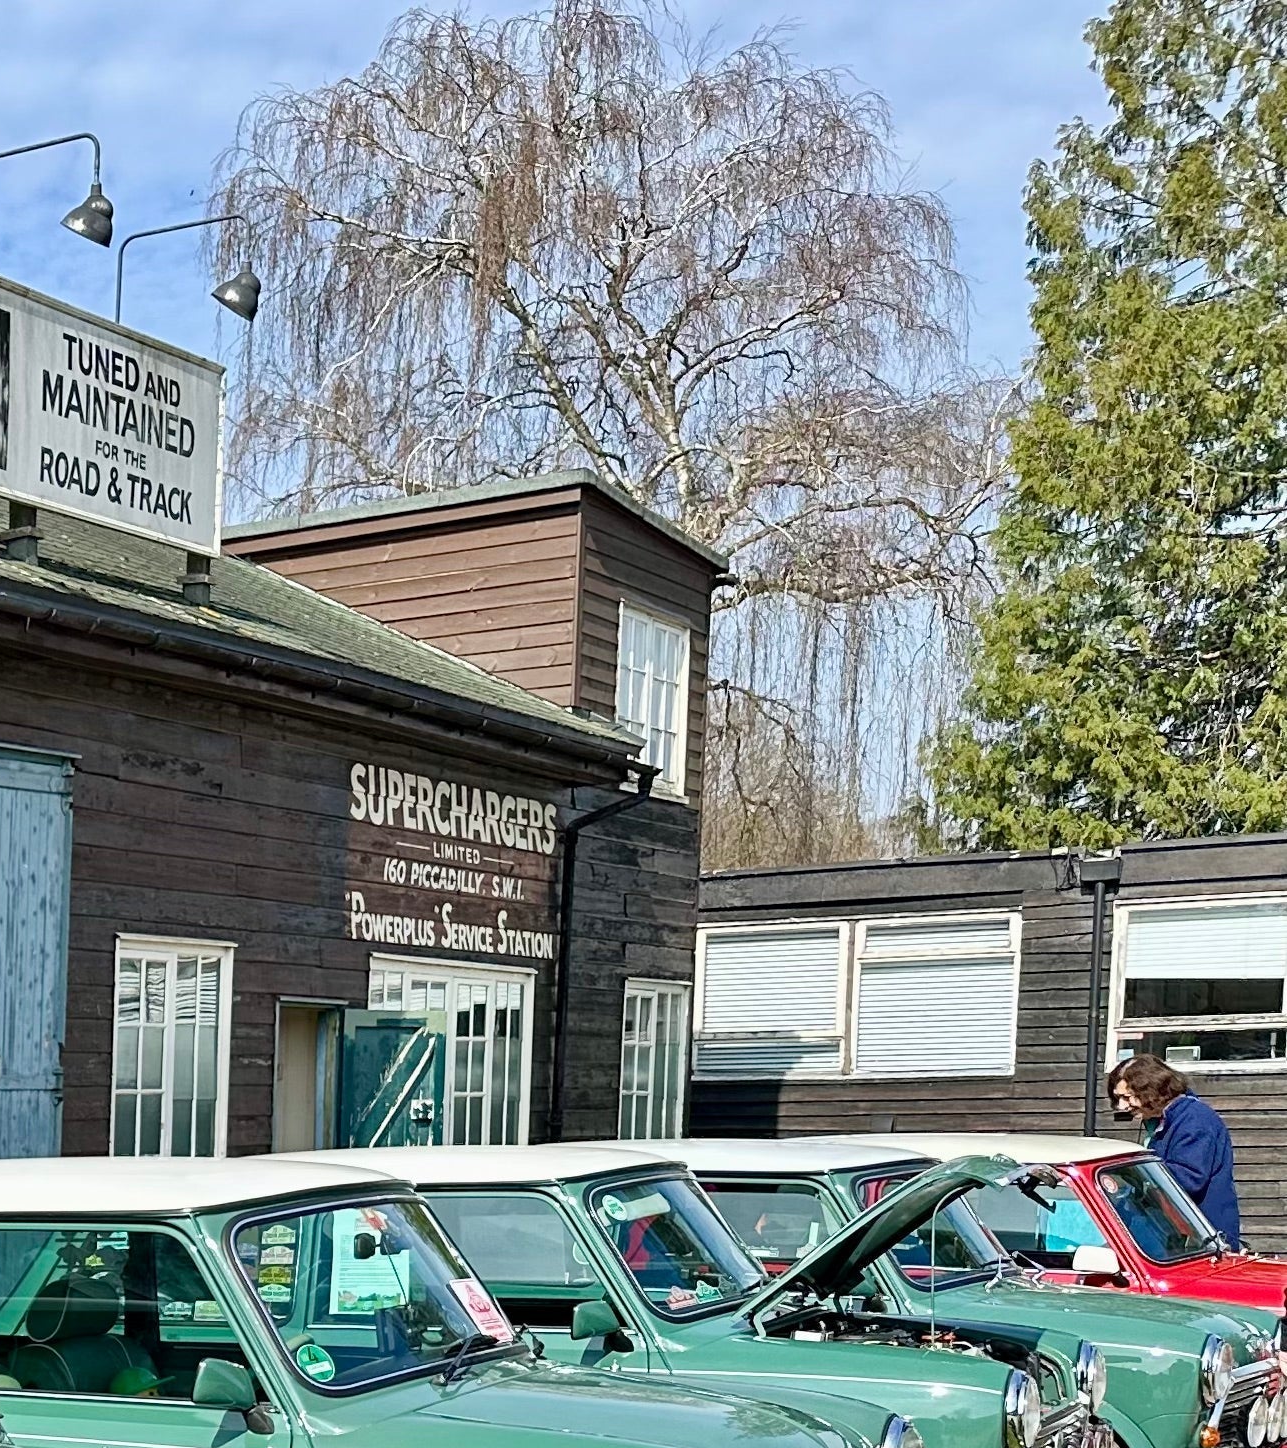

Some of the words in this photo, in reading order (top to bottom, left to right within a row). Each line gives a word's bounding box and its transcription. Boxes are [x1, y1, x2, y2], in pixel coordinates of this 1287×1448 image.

[62, 332, 140, 393] TUNED
[144, 370, 181, 407] AND
[41, 370, 195, 458] MAINTAINED
[40, 448, 101, 499] ROAD
[106, 468, 124, 504] &
[127, 472, 193, 525] TRACK
[95, 439, 122, 463] FOR
[123, 449, 147, 471] THE
[349, 763, 558, 855] SUPERCHARGERS
[383, 857, 406, 884] 160
[433, 842, 481, 865] LIMITED
[441, 902, 494, 954] SERVICE
[497, 910, 554, 960] STATION
